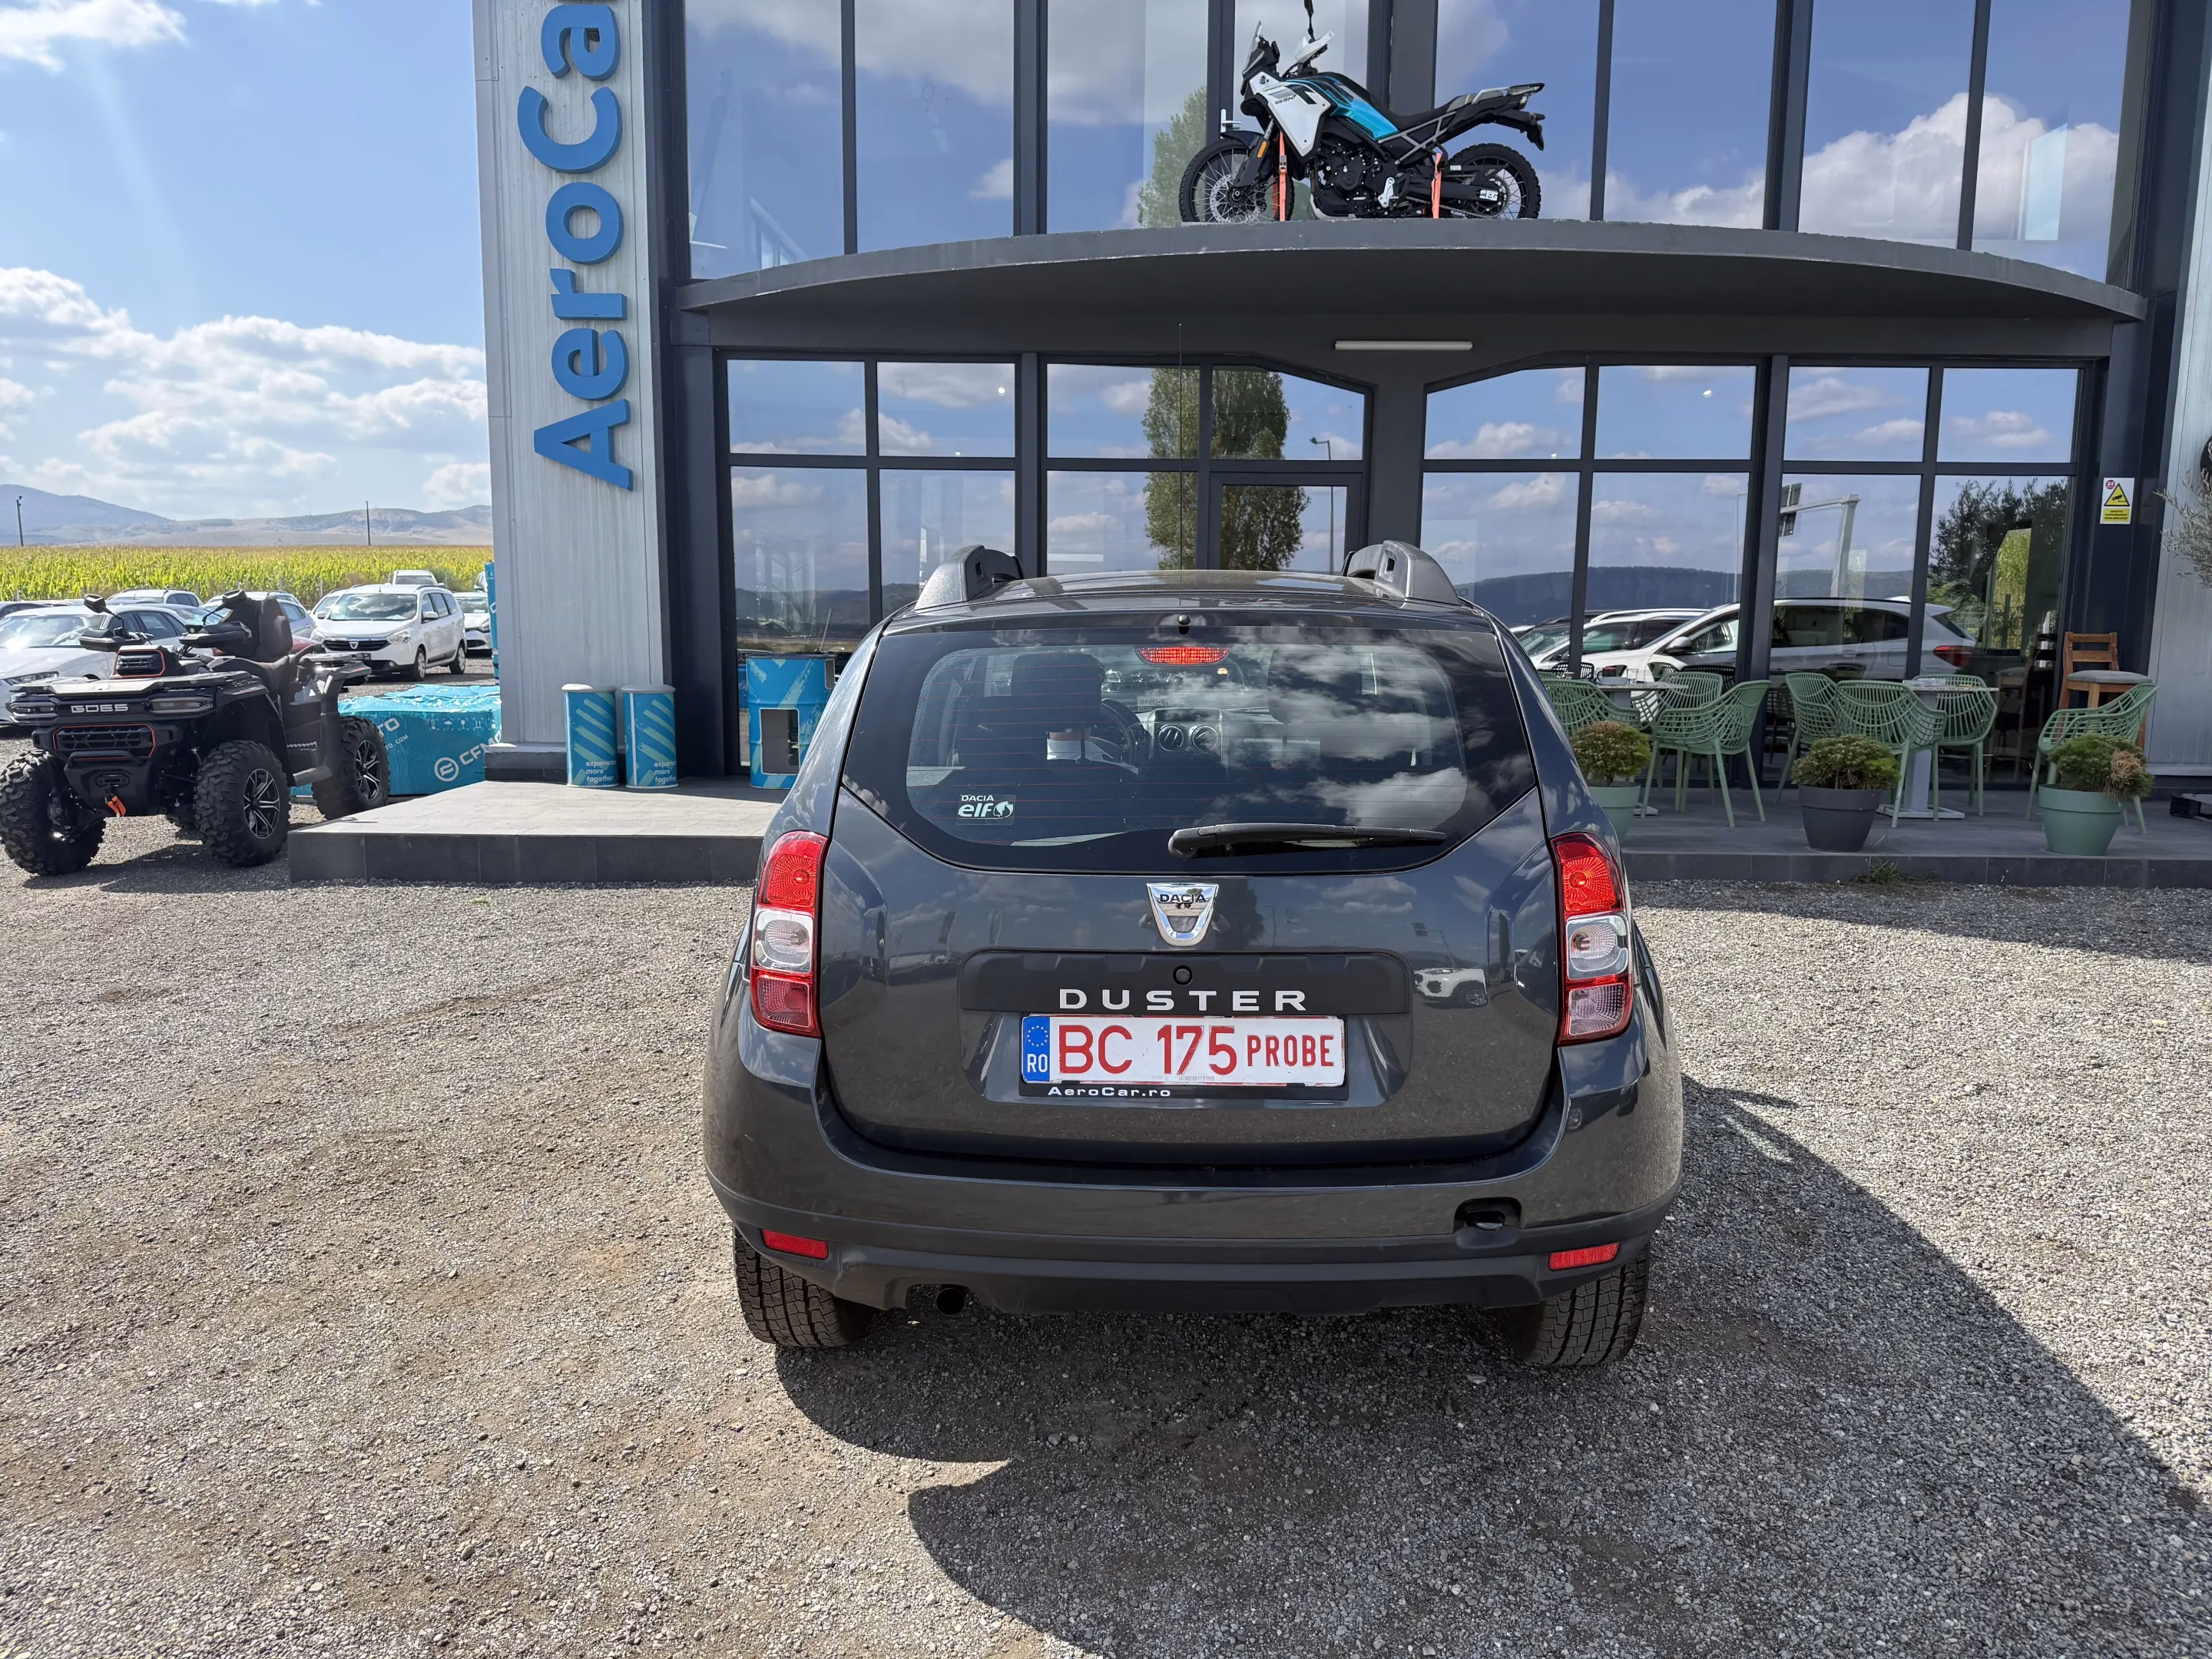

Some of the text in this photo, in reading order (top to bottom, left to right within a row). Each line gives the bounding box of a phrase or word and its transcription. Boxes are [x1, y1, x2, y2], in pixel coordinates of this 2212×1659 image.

[518, 0, 633, 492] AeroCa
[71, 704, 128, 713] GOES
[587, 774, 614, 783] together
[958, 803, 994, 817] elf
[1160, 894, 1206, 902] DACIA
[1059, 988, 1306, 1011] DUSTER
[1059, 1025, 1335, 1075] BC 175 PROBE
[1028, 1053, 1048, 1073] RO
[1048, 1086, 1171, 1098] AeroCar.ro
